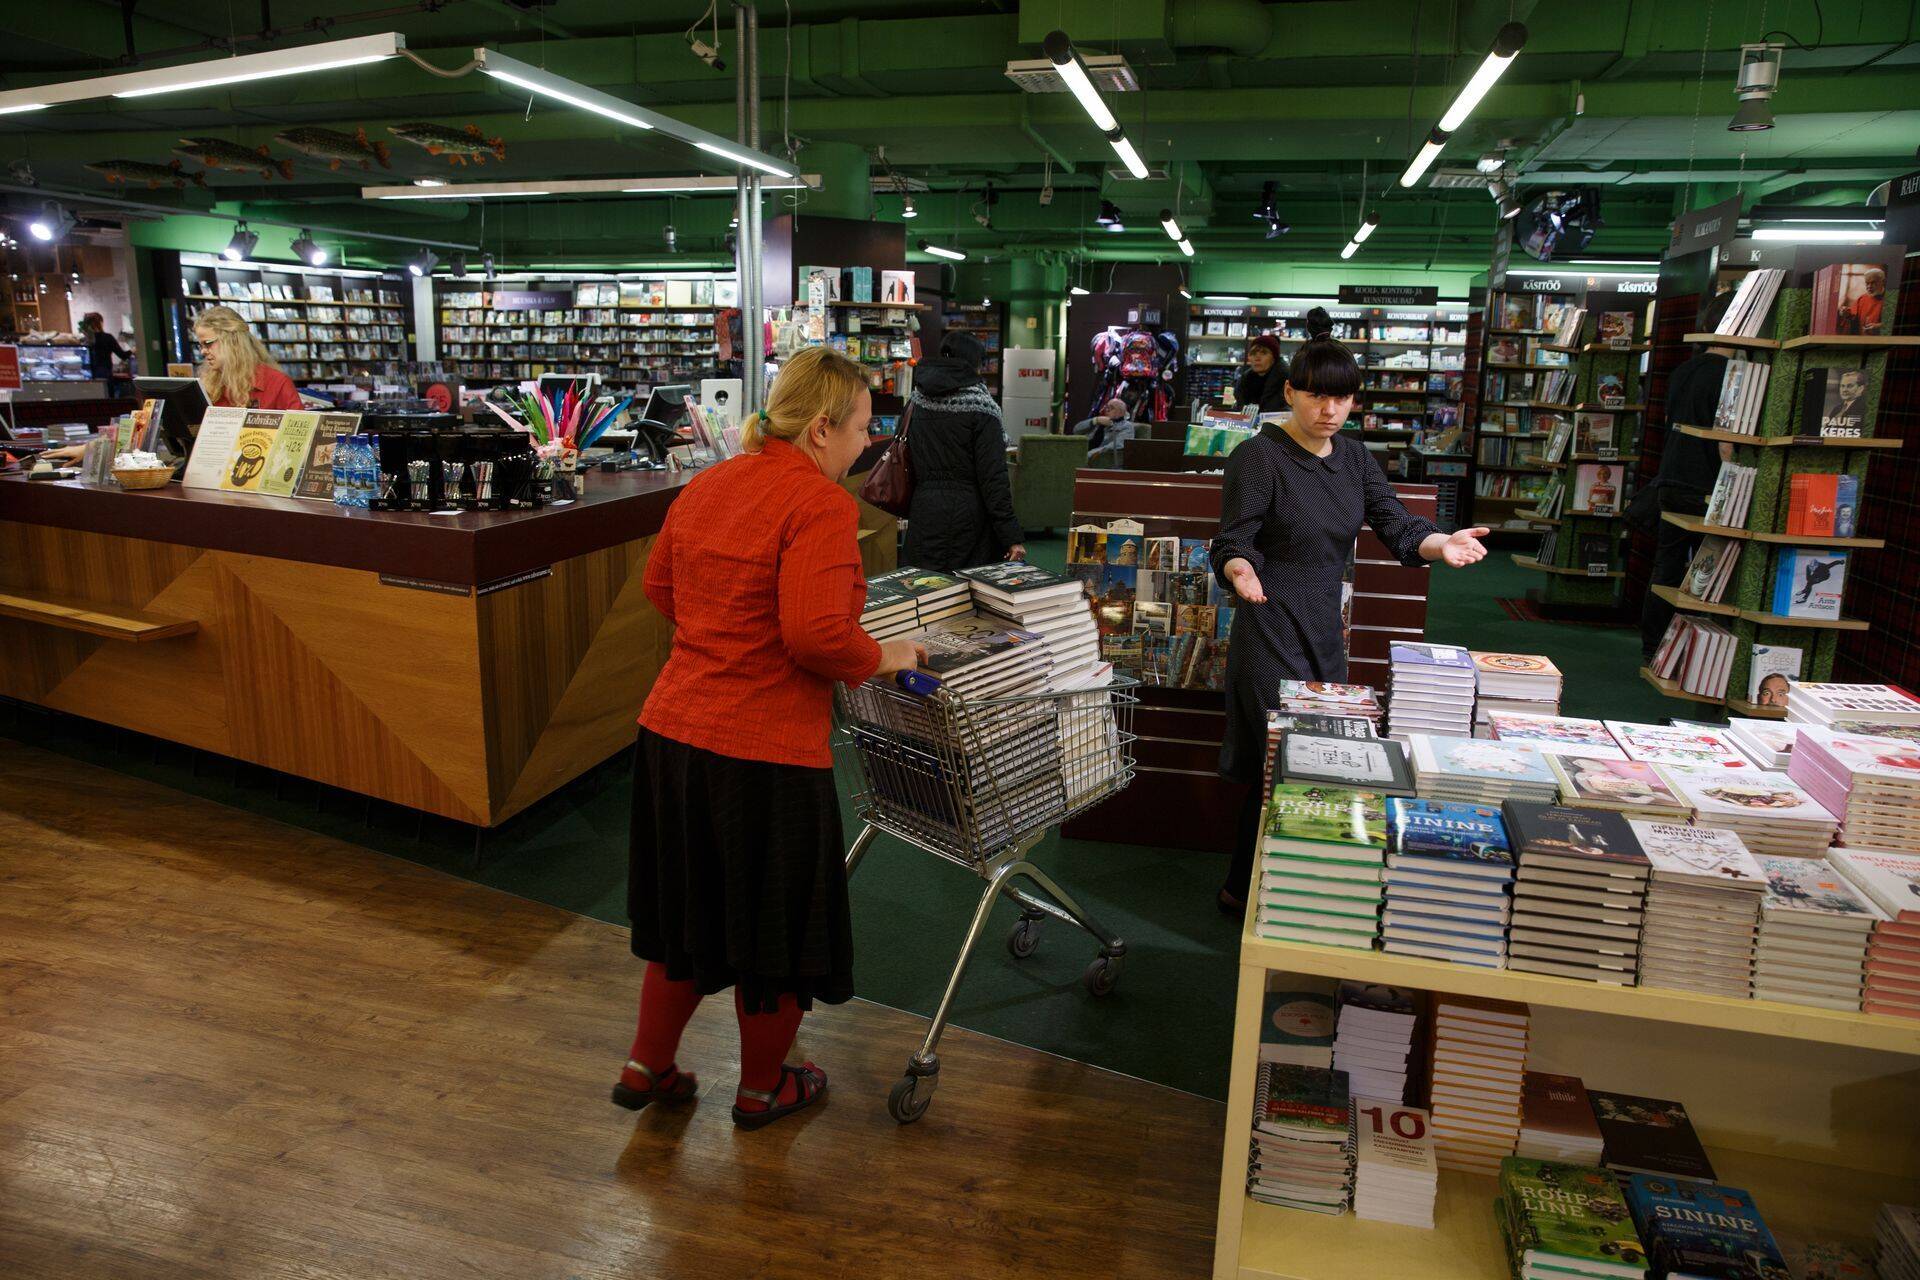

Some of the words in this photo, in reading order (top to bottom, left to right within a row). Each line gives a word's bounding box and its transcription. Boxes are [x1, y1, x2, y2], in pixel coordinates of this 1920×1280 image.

[1901, 176, 1920, 196] RAH
[1523, 279, 1561, 291] KÄSITÖÖ
[1617, 280, 1657, 293] KÄSITÖÖ
[1822, 416, 1855, 427] PAUL
[1820, 428, 1861, 438] KERES
[1278, 806, 1339, 818] LINE
[1279, 799, 1349, 812] ROHE
[1361, 1106, 1426, 1140] 10
[1519, 1185, 1591, 1208] ROHE
[1522, 1197, 1585, 1219] LINE
[1654, 1204, 1759, 1233] SININE
